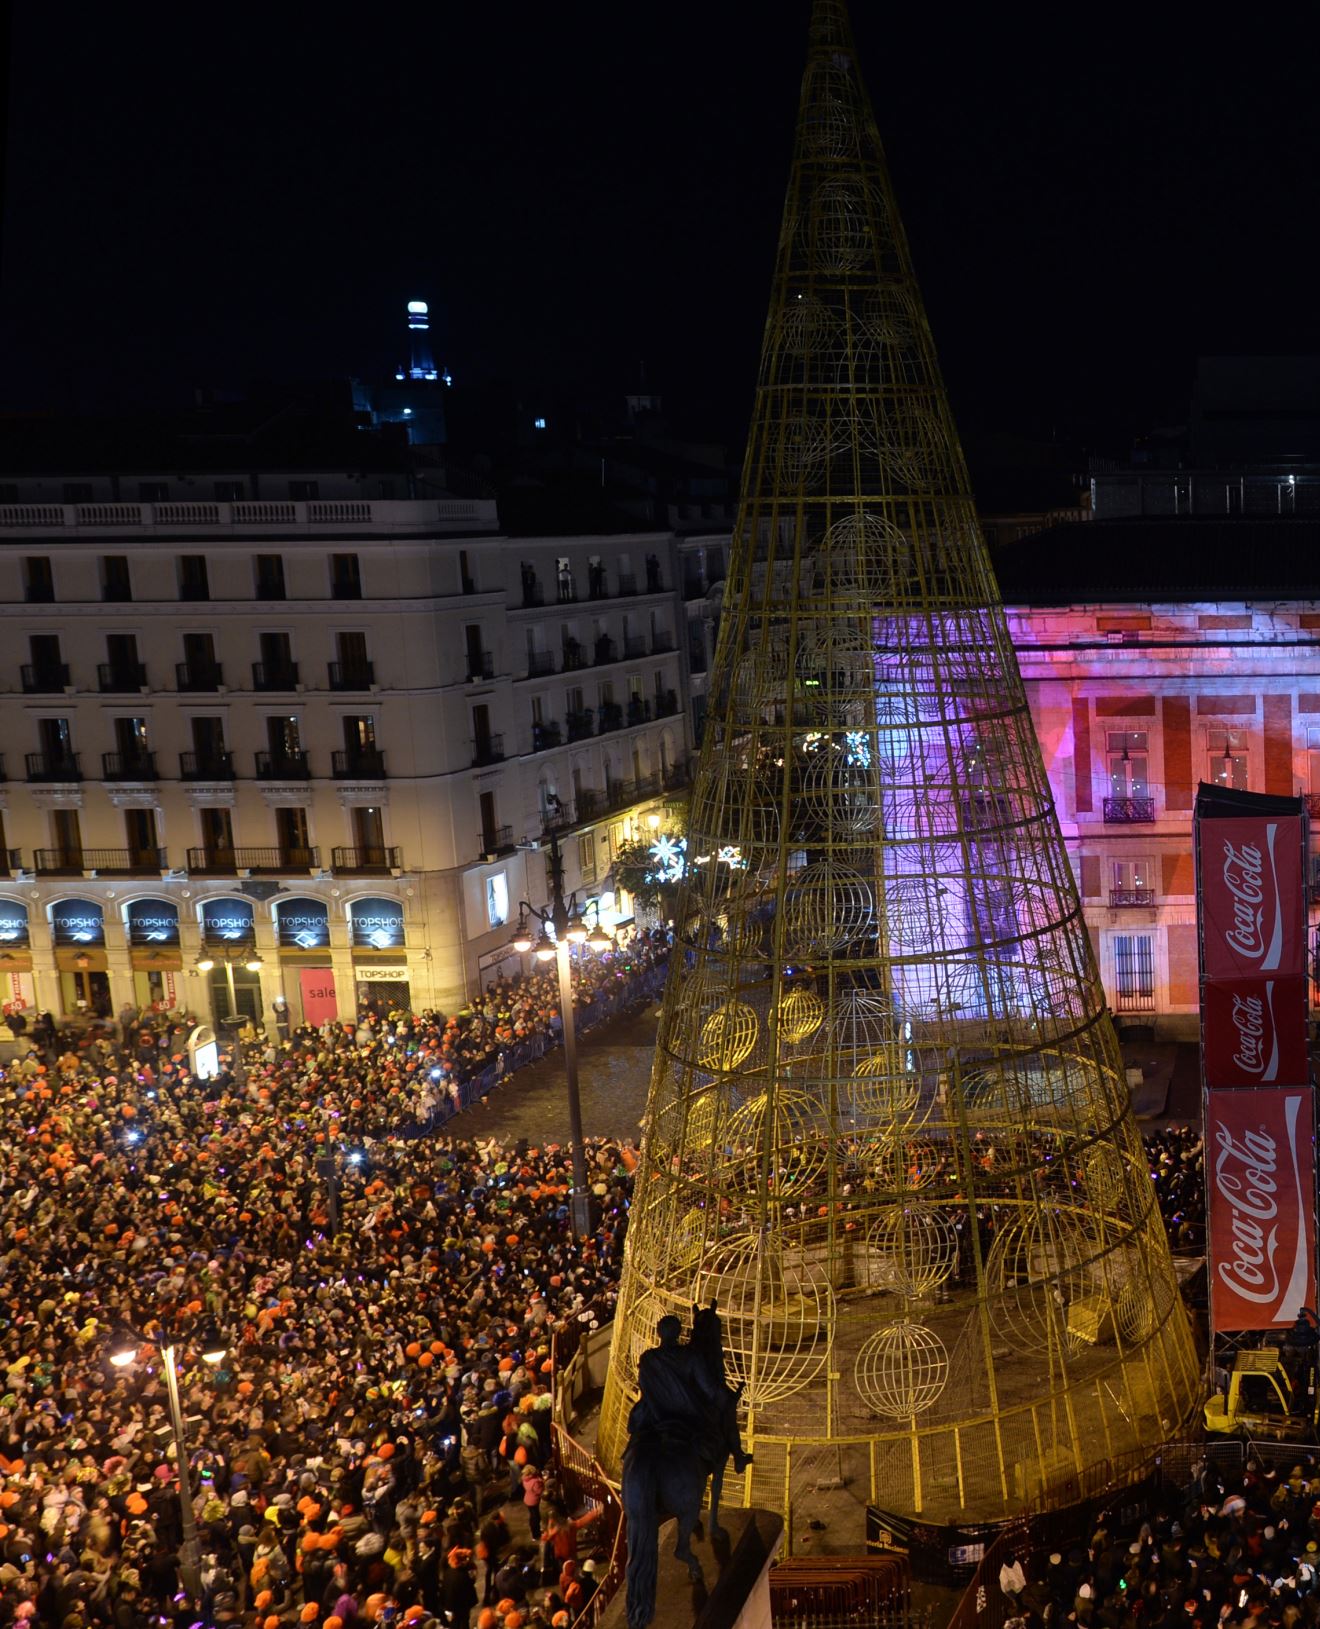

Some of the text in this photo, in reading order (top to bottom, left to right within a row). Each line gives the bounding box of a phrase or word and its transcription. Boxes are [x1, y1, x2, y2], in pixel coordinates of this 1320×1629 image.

[1223, 838, 1264, 958] Coca-Cola
[309, 987, 336, 998] sale
[358, 970, 405, 978] TOPSHOP
[1232, 992, 1264, 1073] Coca-Cola
[1215, 1119, 1280, 1304] Coca-Cola
